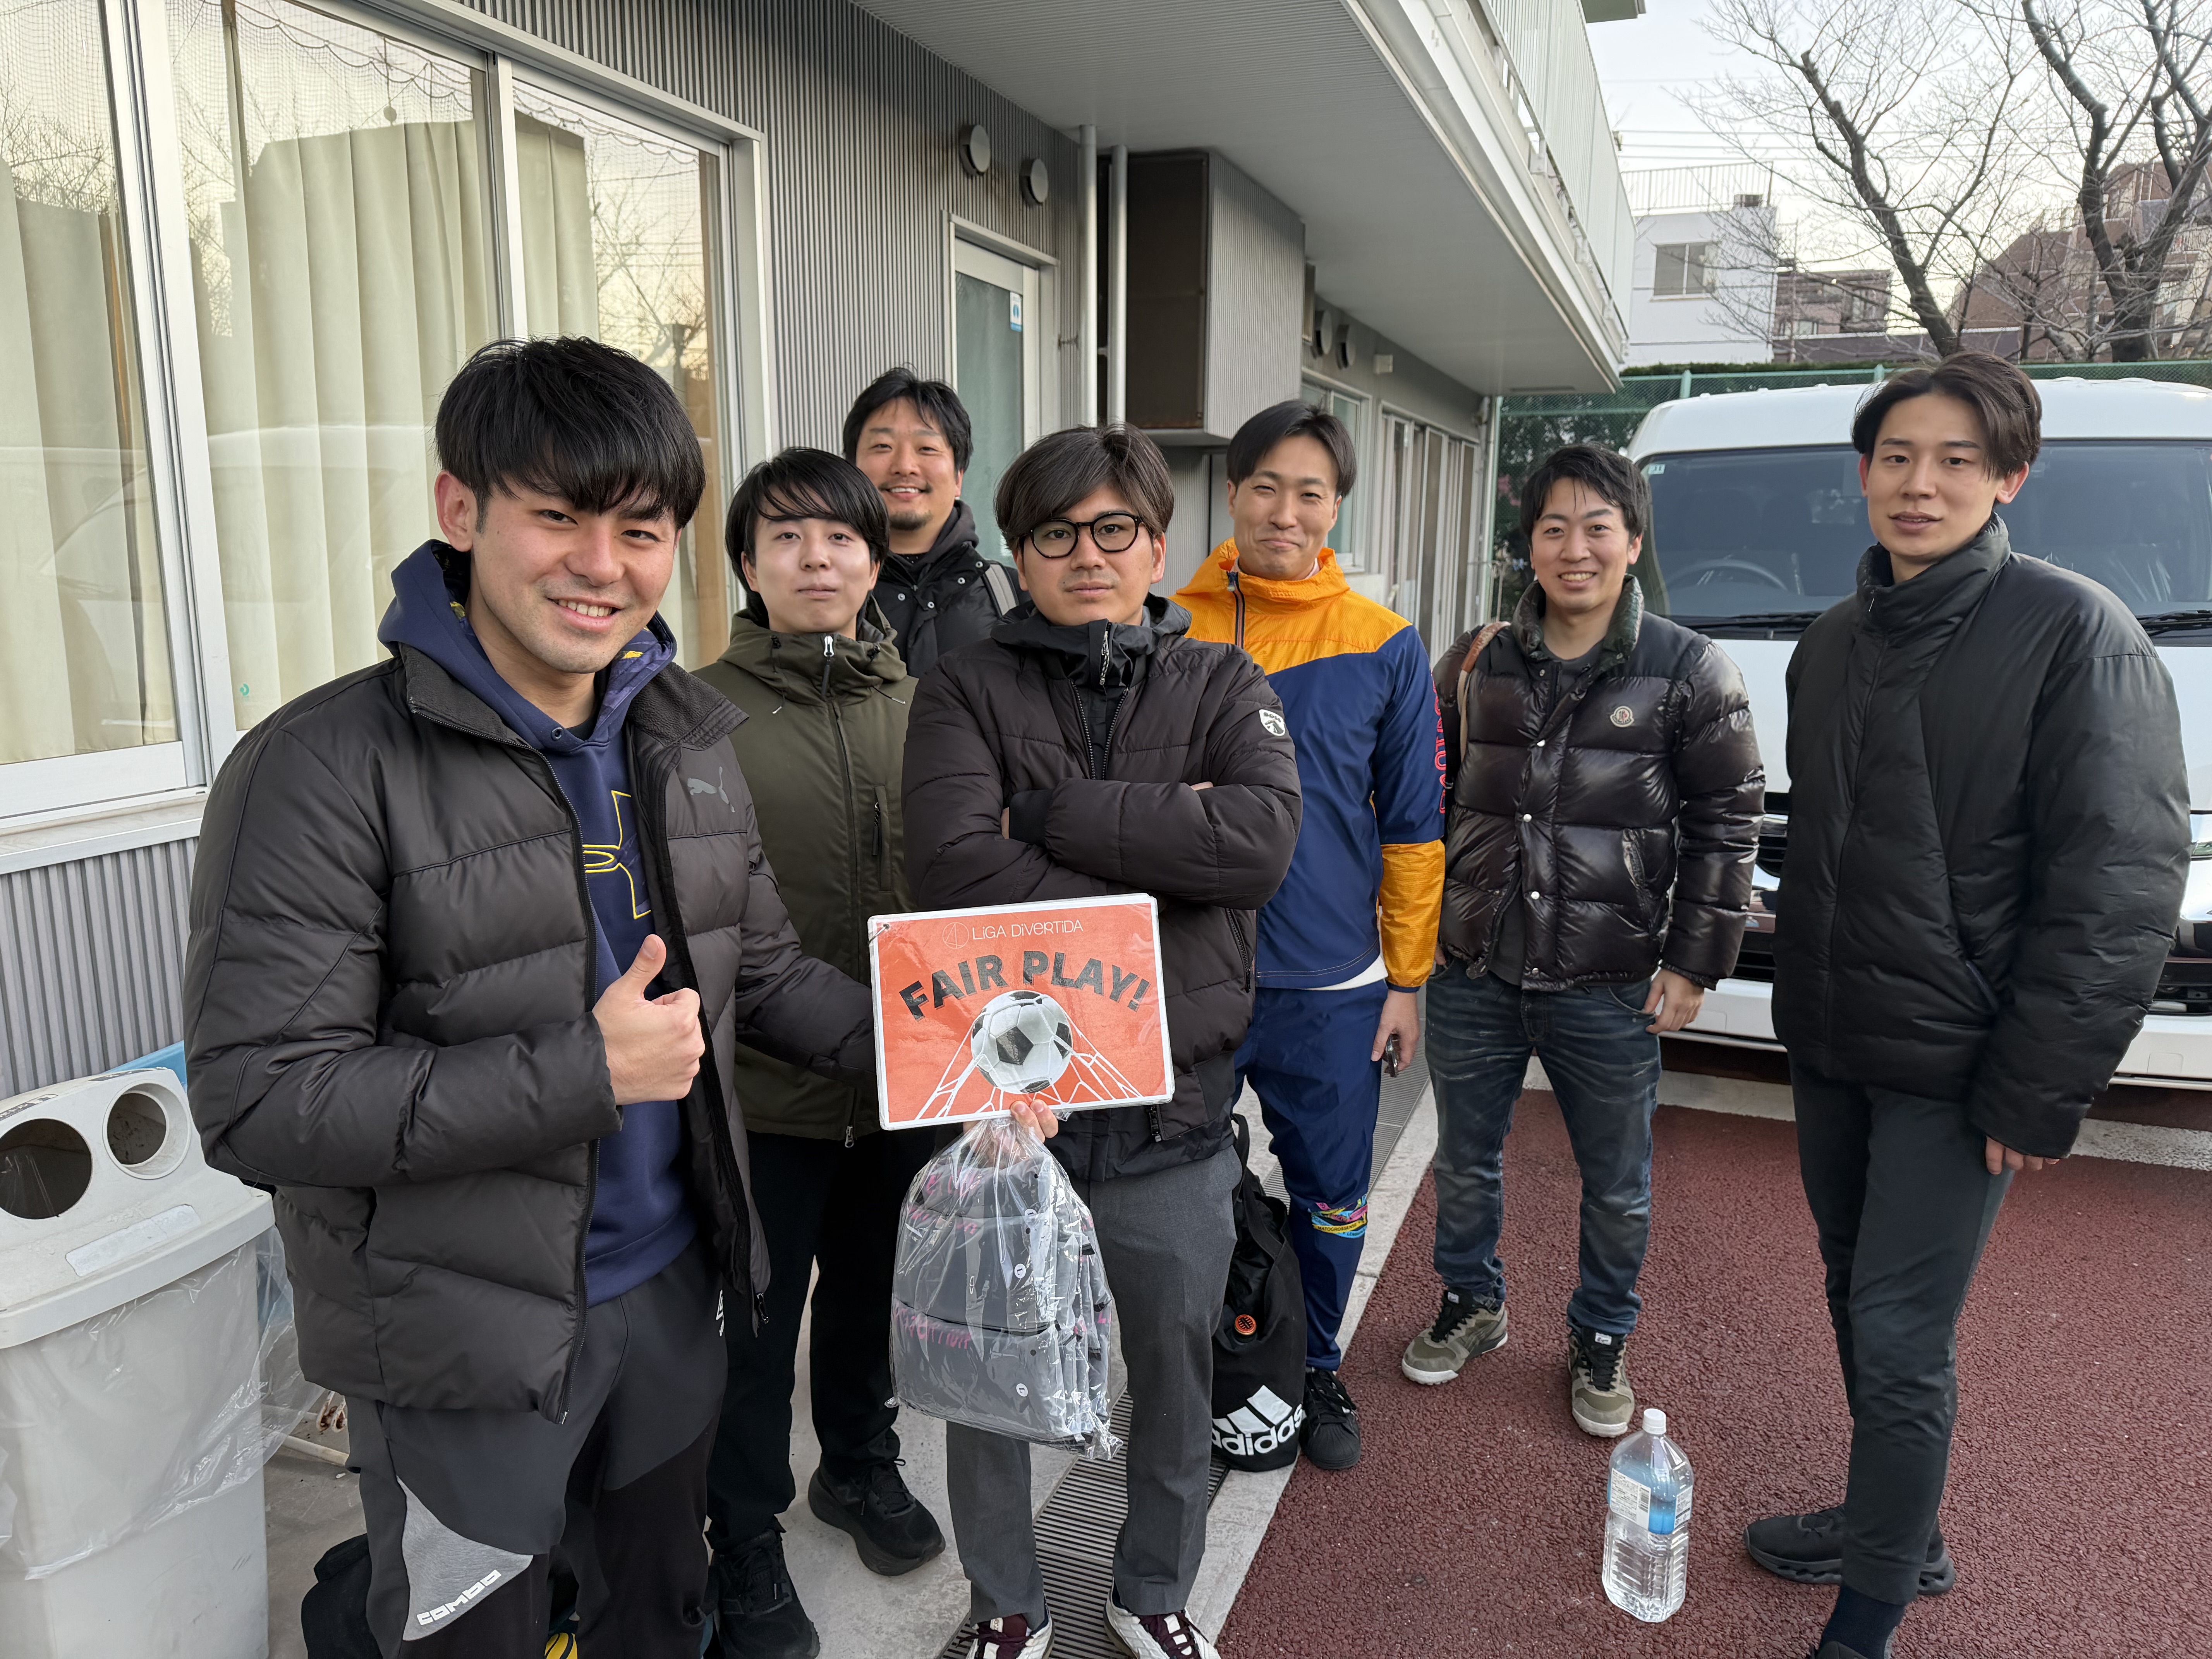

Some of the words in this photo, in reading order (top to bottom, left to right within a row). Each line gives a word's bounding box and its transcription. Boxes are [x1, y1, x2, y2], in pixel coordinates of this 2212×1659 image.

[898, 954, 1010, 1022] FAIR
[1023, 950, 1152, 1012] PLAY!
[1212, 1404, 1303, 1456] adidas
